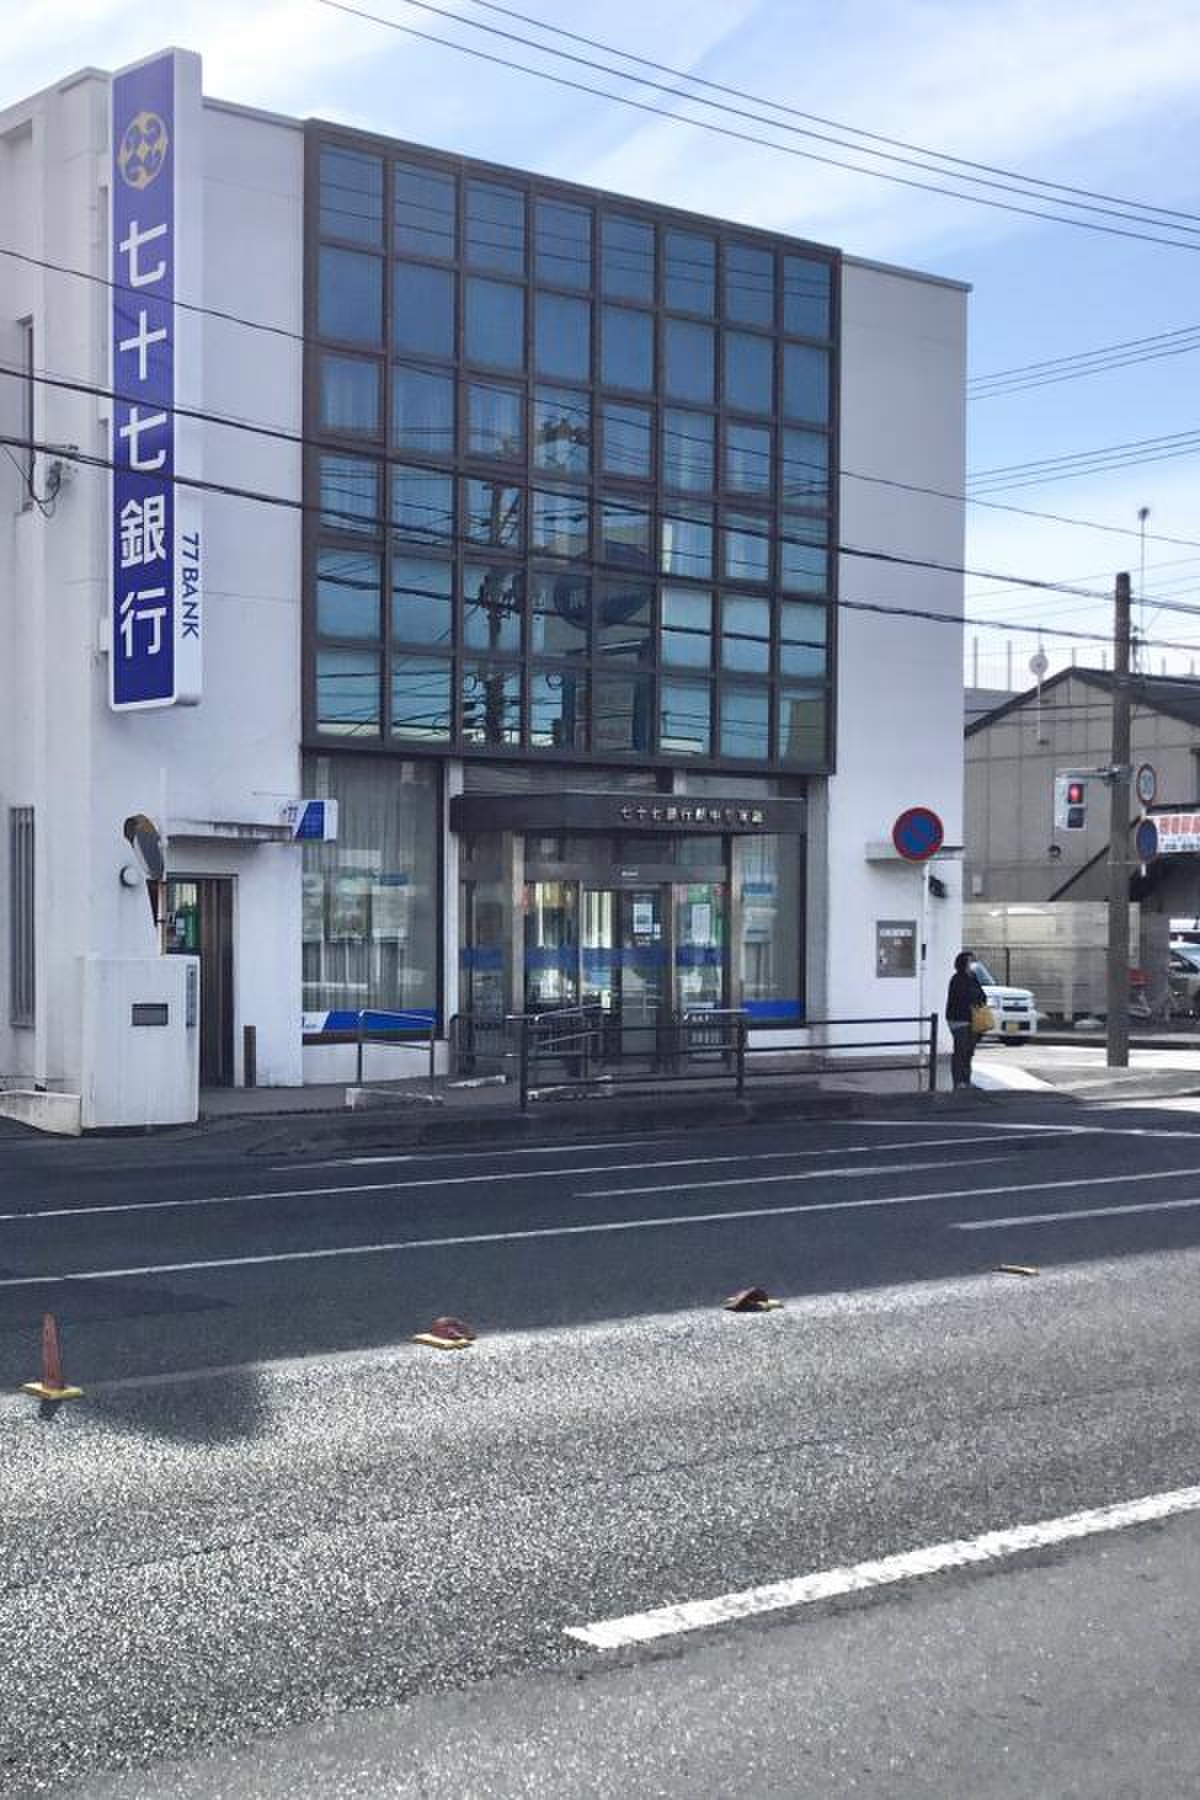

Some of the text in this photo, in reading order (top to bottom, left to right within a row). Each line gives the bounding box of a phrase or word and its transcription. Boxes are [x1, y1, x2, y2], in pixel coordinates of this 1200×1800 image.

[119, 220, 168, 658] 七十七銀行
